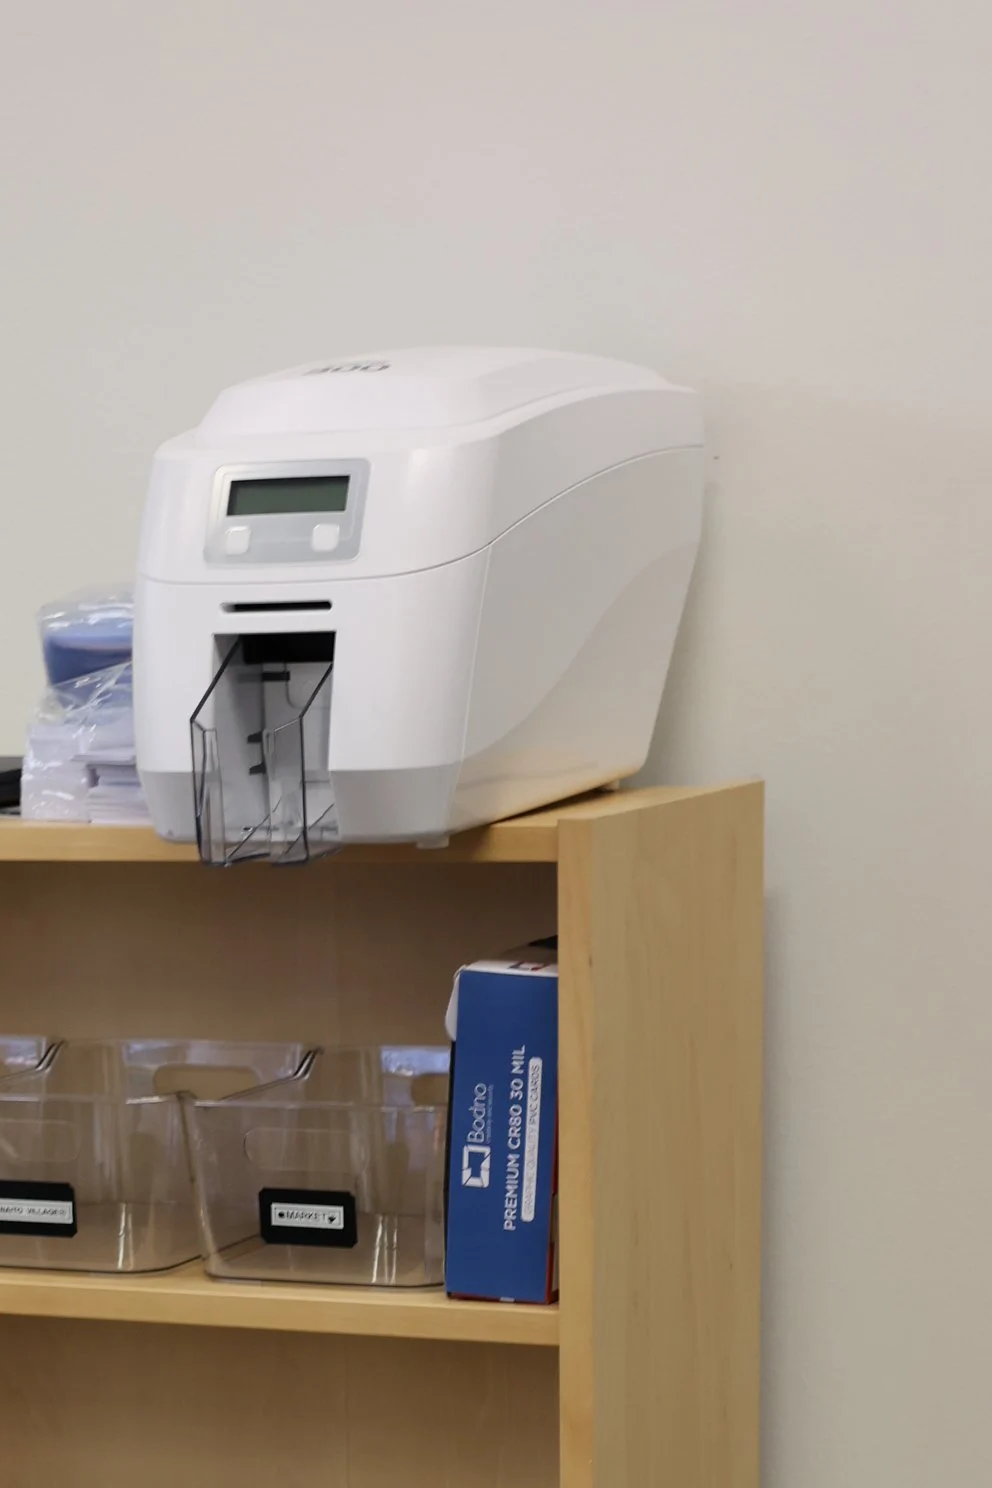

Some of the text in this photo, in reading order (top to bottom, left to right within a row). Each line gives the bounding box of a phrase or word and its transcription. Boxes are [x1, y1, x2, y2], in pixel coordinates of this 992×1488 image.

[530, 1064, 540, 1102] CARDS
[467, 1083, 487, 1143] Bodno
[528, 1103, 538, 1125] PVC
[504, 1045, 525, 1231] PREMIUM CR80 30 MIL
[286, 1210, 326, 1220] MARKET
